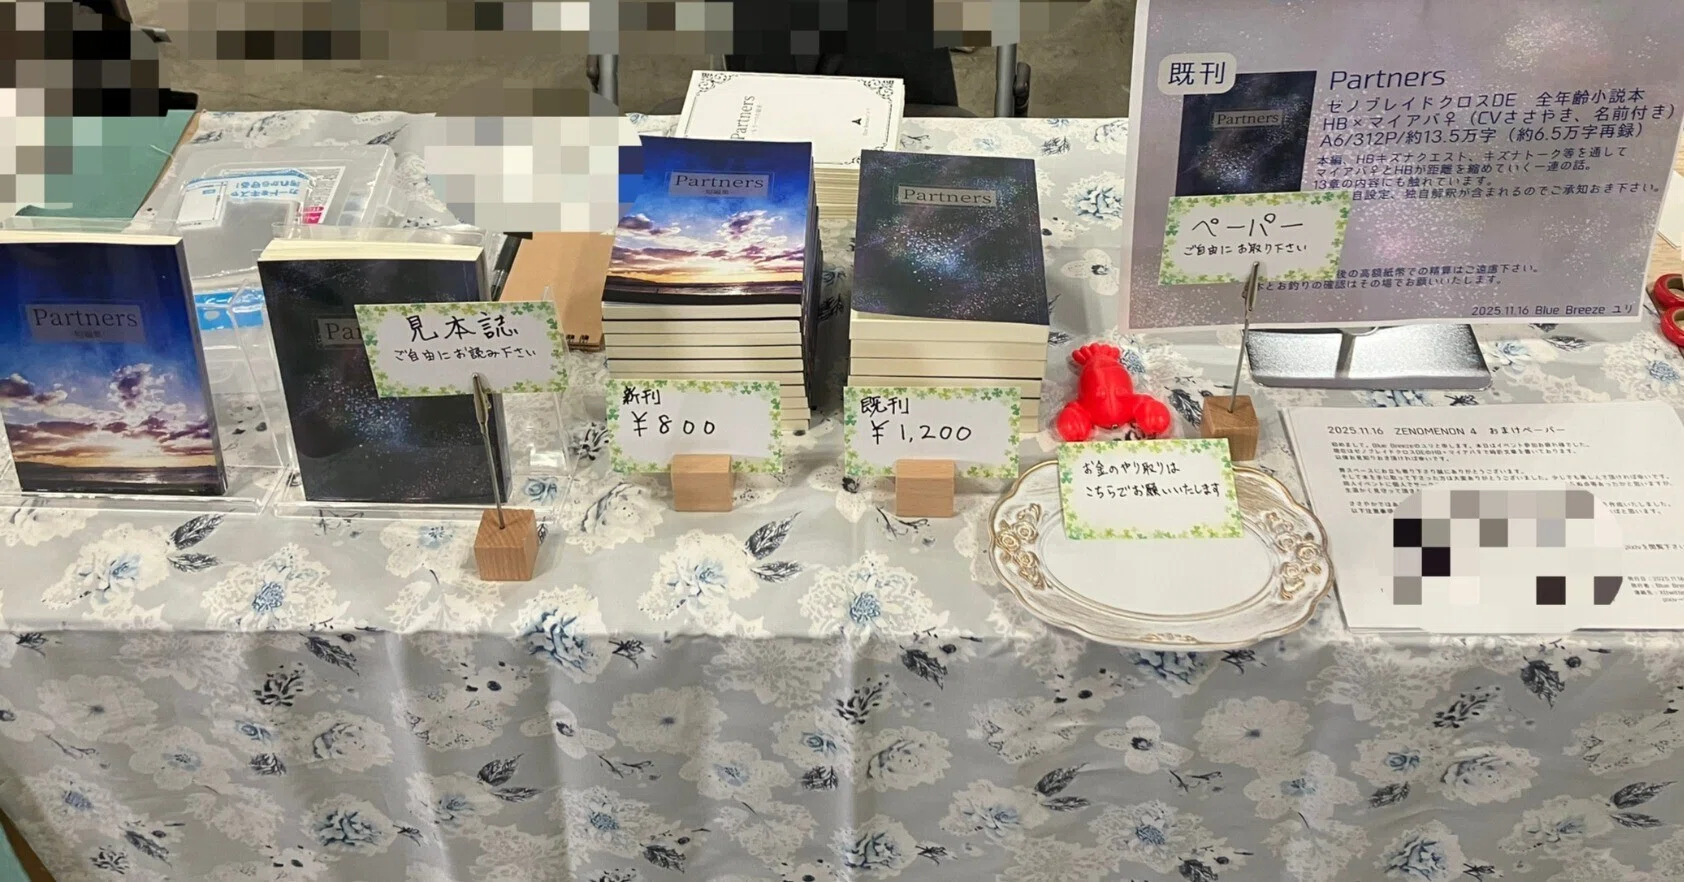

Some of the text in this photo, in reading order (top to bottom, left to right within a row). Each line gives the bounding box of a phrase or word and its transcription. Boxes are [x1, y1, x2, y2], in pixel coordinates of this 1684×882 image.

[1167, 61, 1227, 86] 既刊
[1329, 69, 1447, 91] Partners
[1327, 87, 1646, 114] ゼノブレイドクロスDE 全年齢小説本
[729, 95, 756, 140] Partners
[1217, 113, 1280, 126] Partners
[675, 174, 764, 189] Partners
[903, 188, 992, 204] Partners
[1352, 182, 1661, 201] 自設定、独自解釈が含まれるのでご承知おき下さい。
[1191, 212, 1304, 237] ペーパー
[1183, 242, 1309, 256] ご自由にお取り下さい
[1336, 263, 1539, 279] 後の高額紙幣での精算はご遠慮下さい。
[32, 308, 139, 328] Partners
[1471, 304, 1634, 316] 2025.11.16 Blue Breeze ユリ
[406, 311, 520, 342] 見本誌
[394, 345, 537, 362] ご自由にお読み下さい
[621, 387, 662, 406] 新刊
[860, 395, 911, 416] 既刊
[1327, 425, 1385, 435] 2025.11.16
[1393, 427, 1466, 436] ZENOMENON
[1470, 427, 1478, 435] 4
[1082, 459, 1181, 477] お金のやり取りは
[1085, 482, 1221, 499] こちらでお願いいたします
